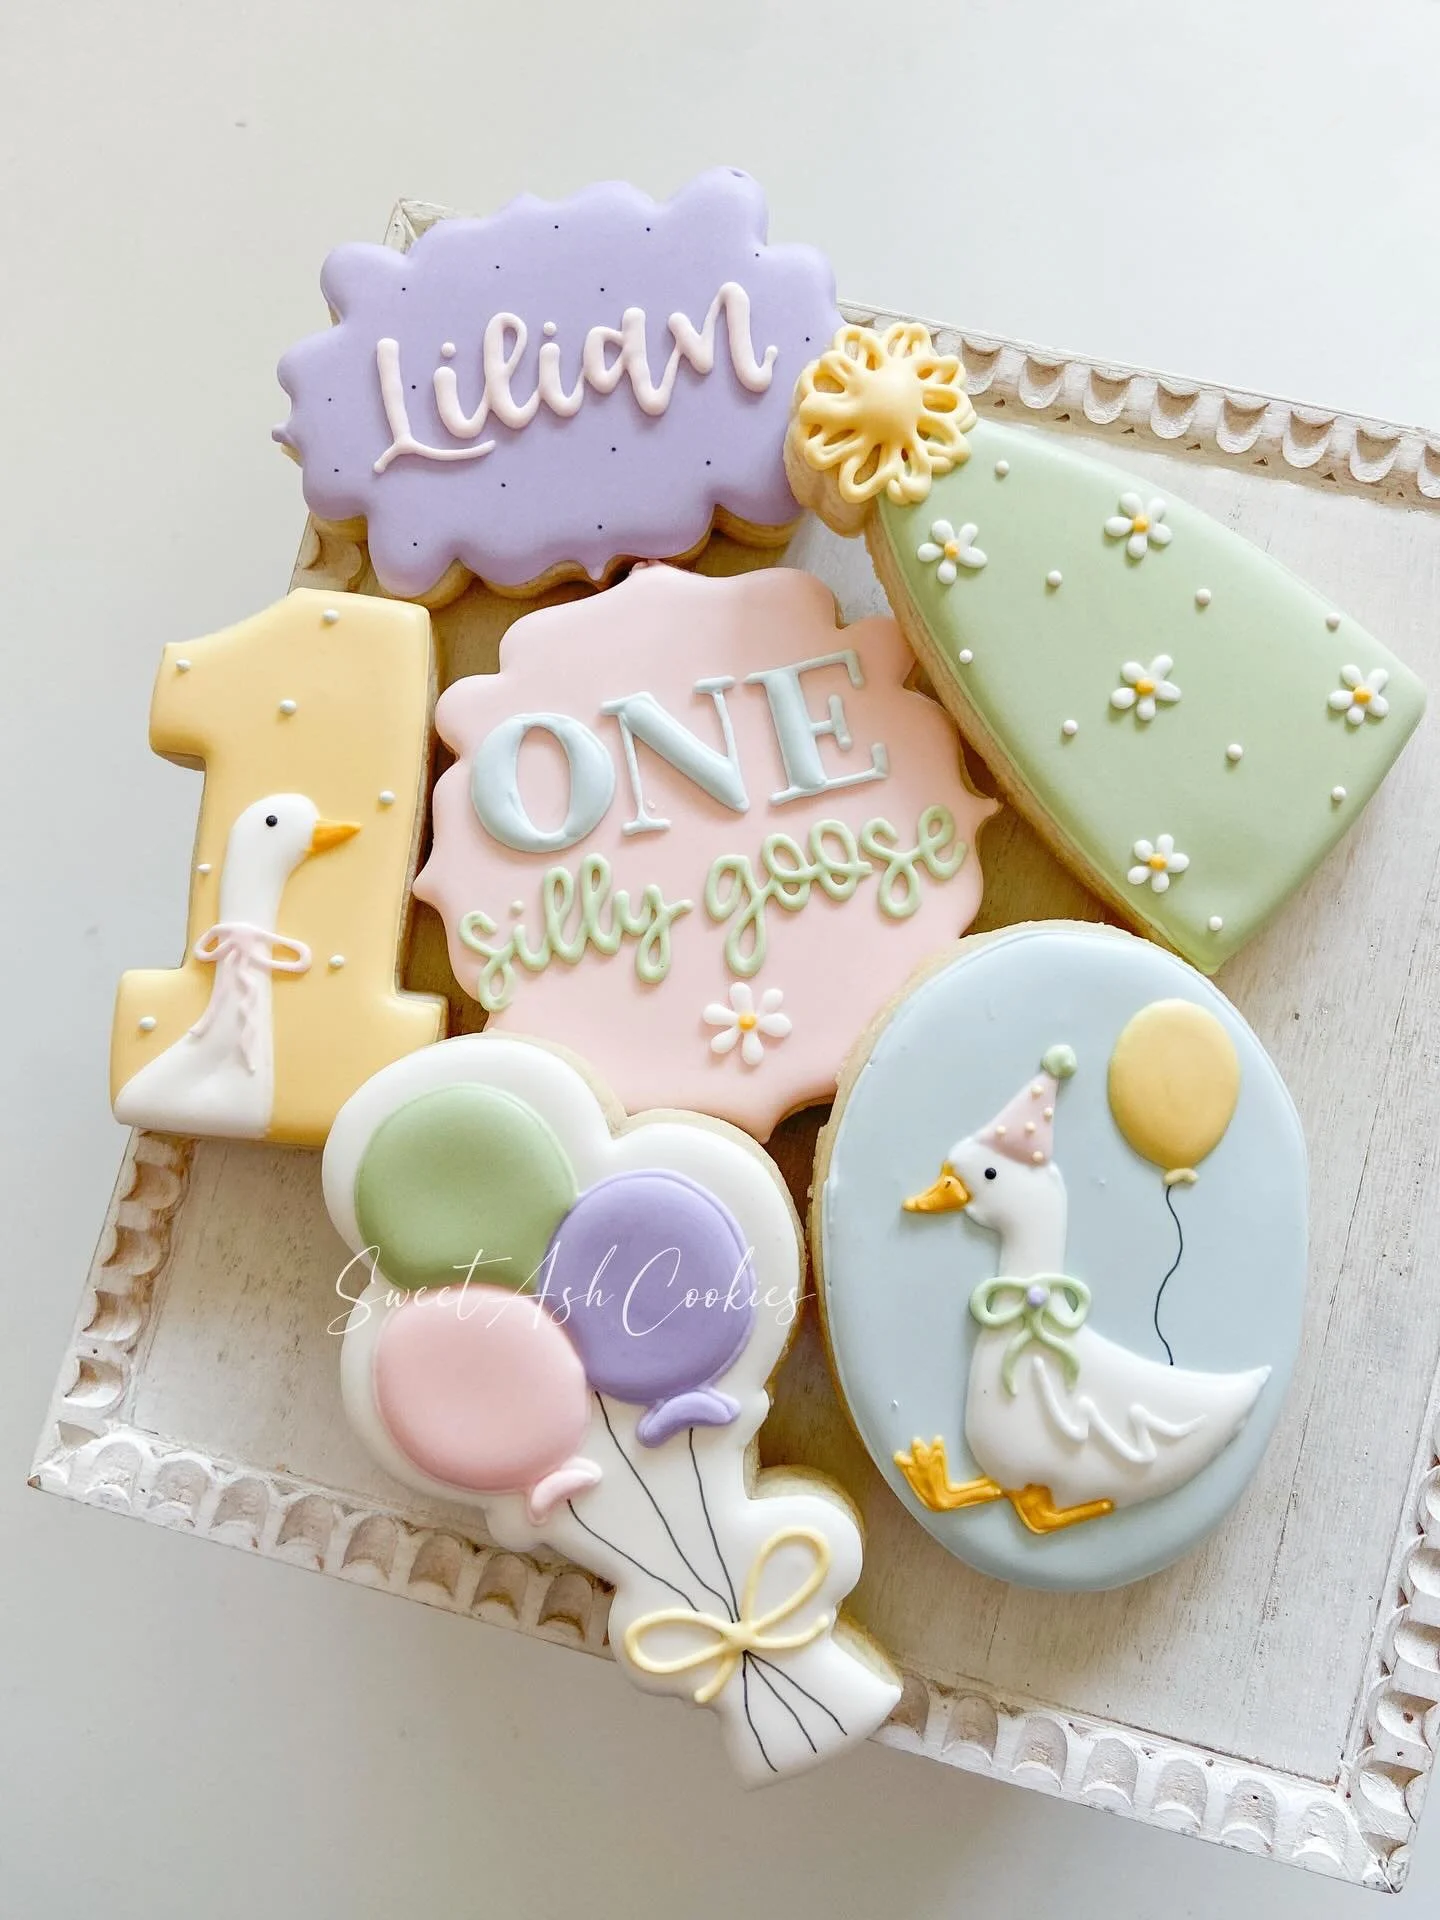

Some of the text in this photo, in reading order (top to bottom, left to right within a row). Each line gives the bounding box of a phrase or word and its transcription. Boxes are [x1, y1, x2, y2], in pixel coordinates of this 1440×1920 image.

[373, 282, 778, 474] Lilian
[471, 649, 888, 853] ONE
[459, 805, 968, 1012] silly goose
